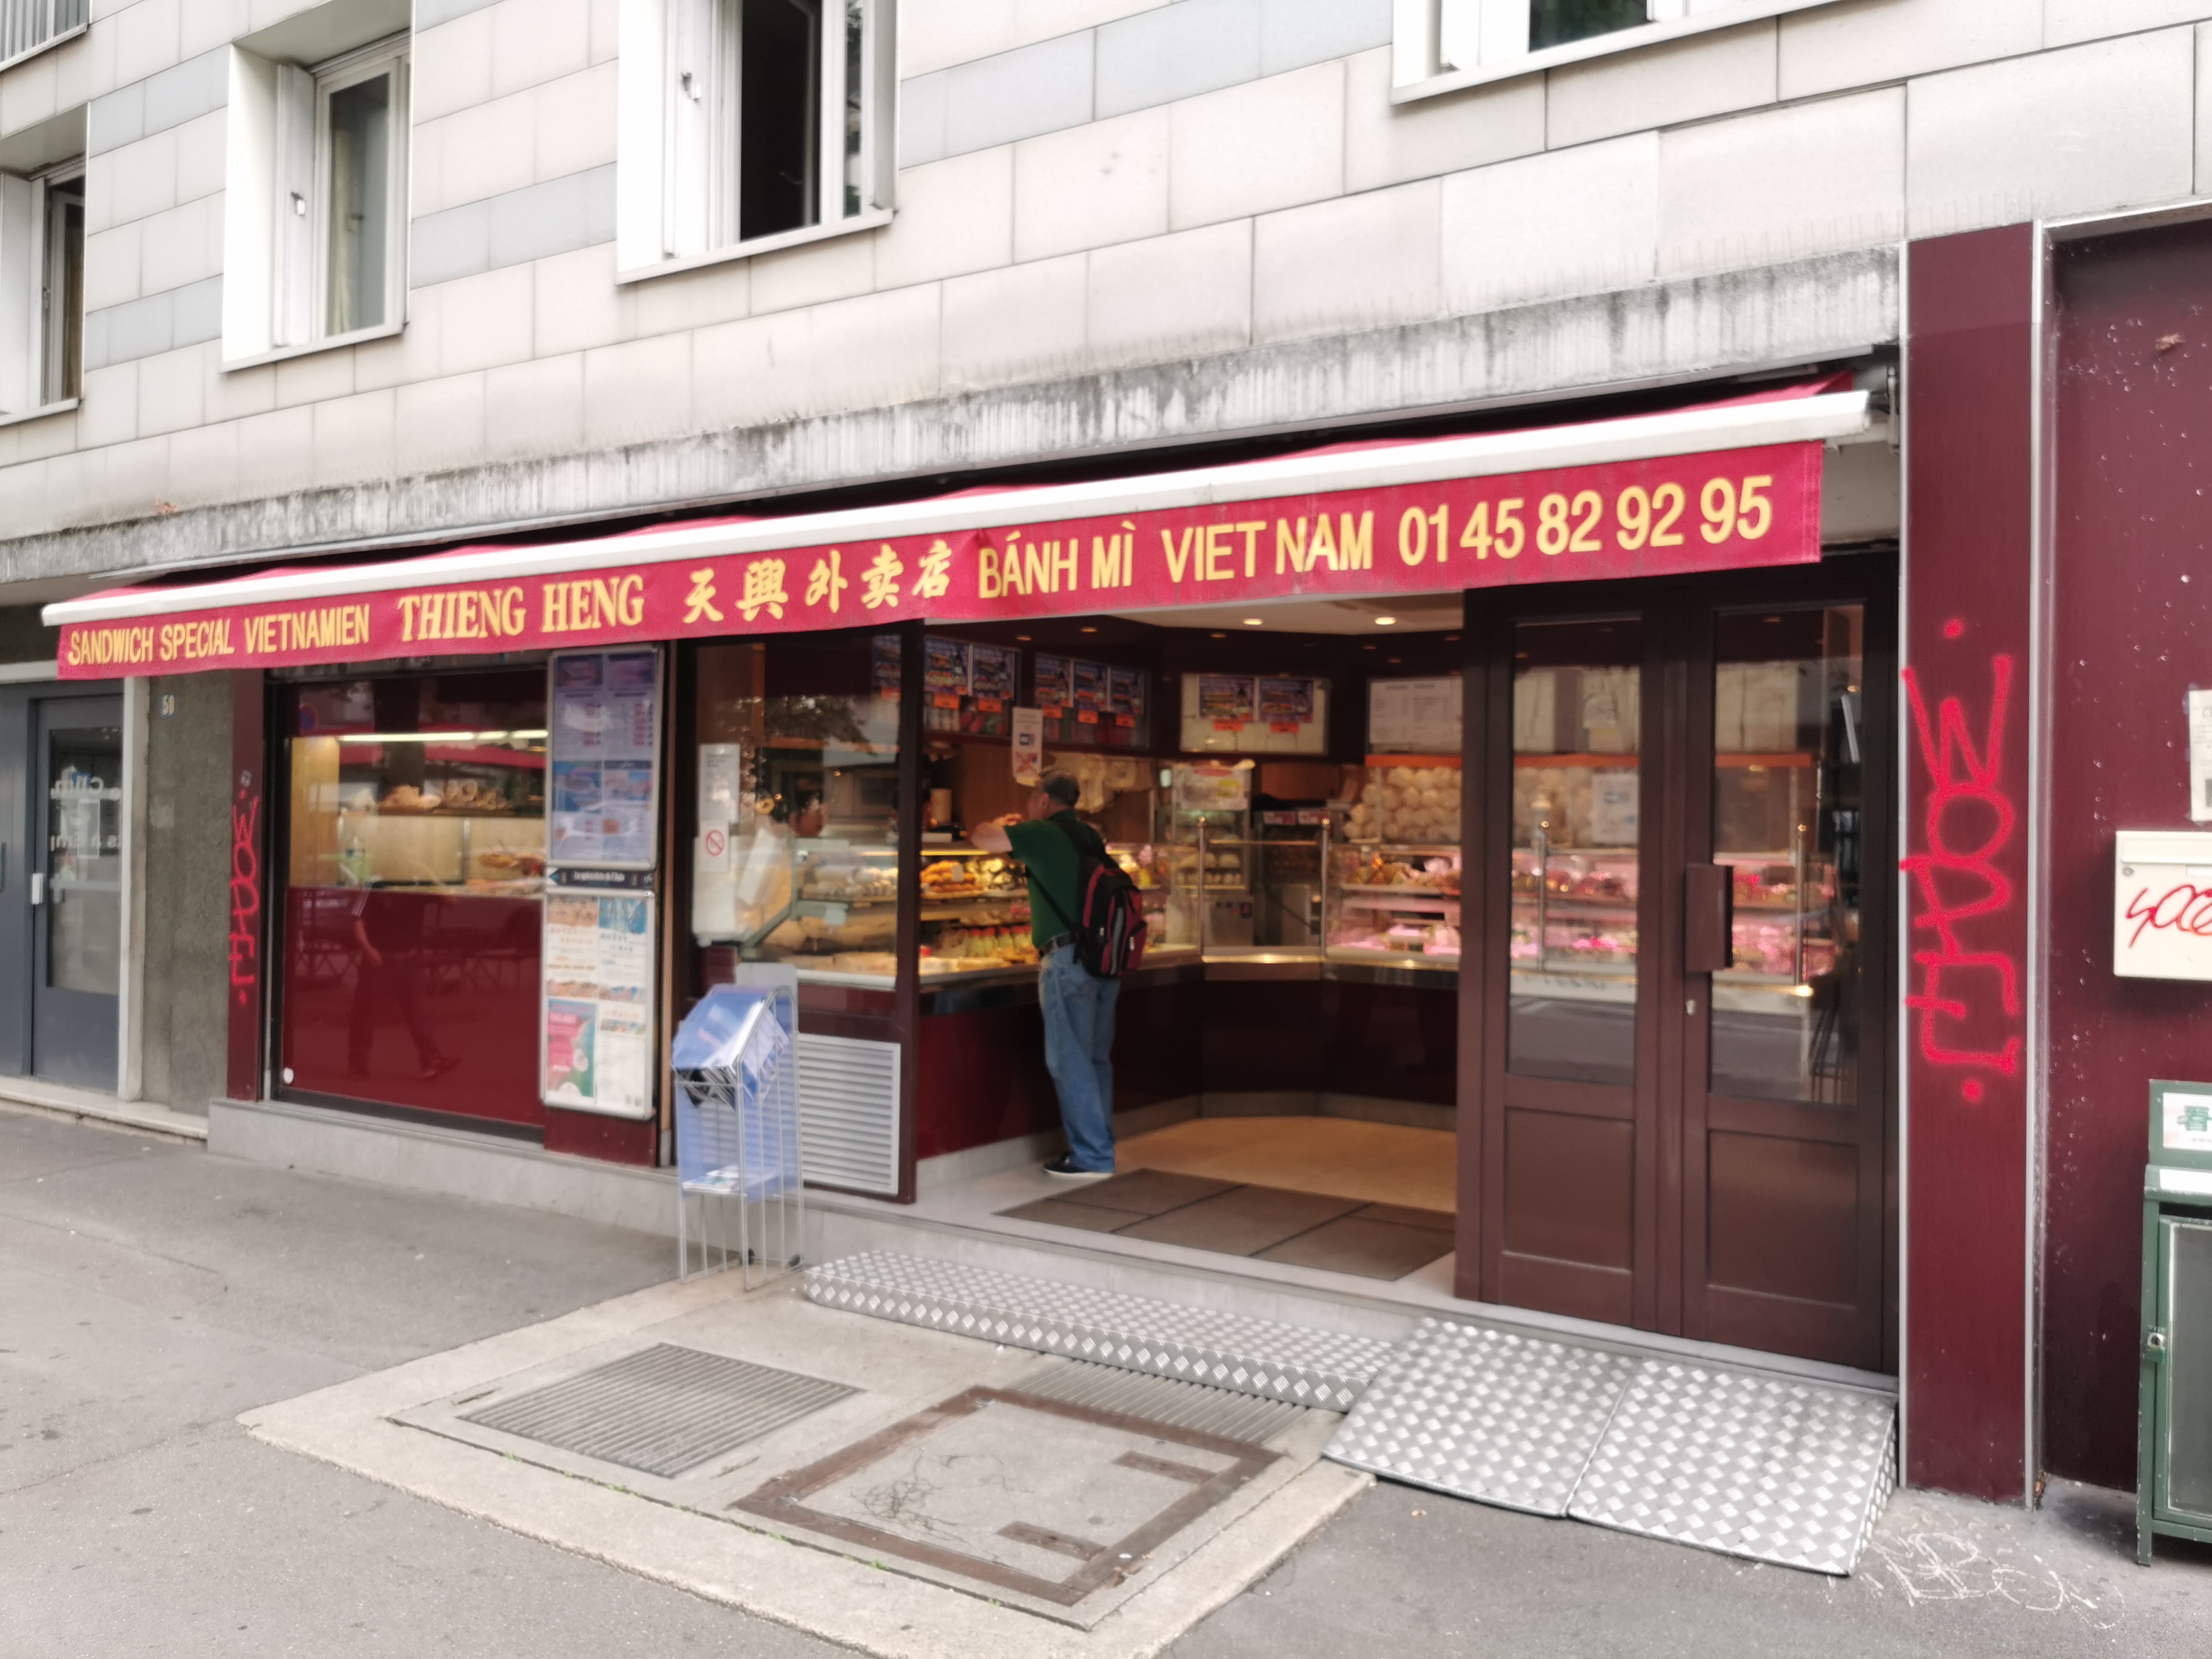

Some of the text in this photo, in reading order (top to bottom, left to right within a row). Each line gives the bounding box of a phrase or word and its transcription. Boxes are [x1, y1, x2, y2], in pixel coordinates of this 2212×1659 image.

[978, 475, 1773, 600] BÁNH MÌ VIET NAM 01 45 82 92 95
[67, 603, 371, 666] SANDWICH SPECIAL VIETNAMIEN
[397, 574, 645, 643] THIENG HENG
[162, 694, 175, 716] 50
